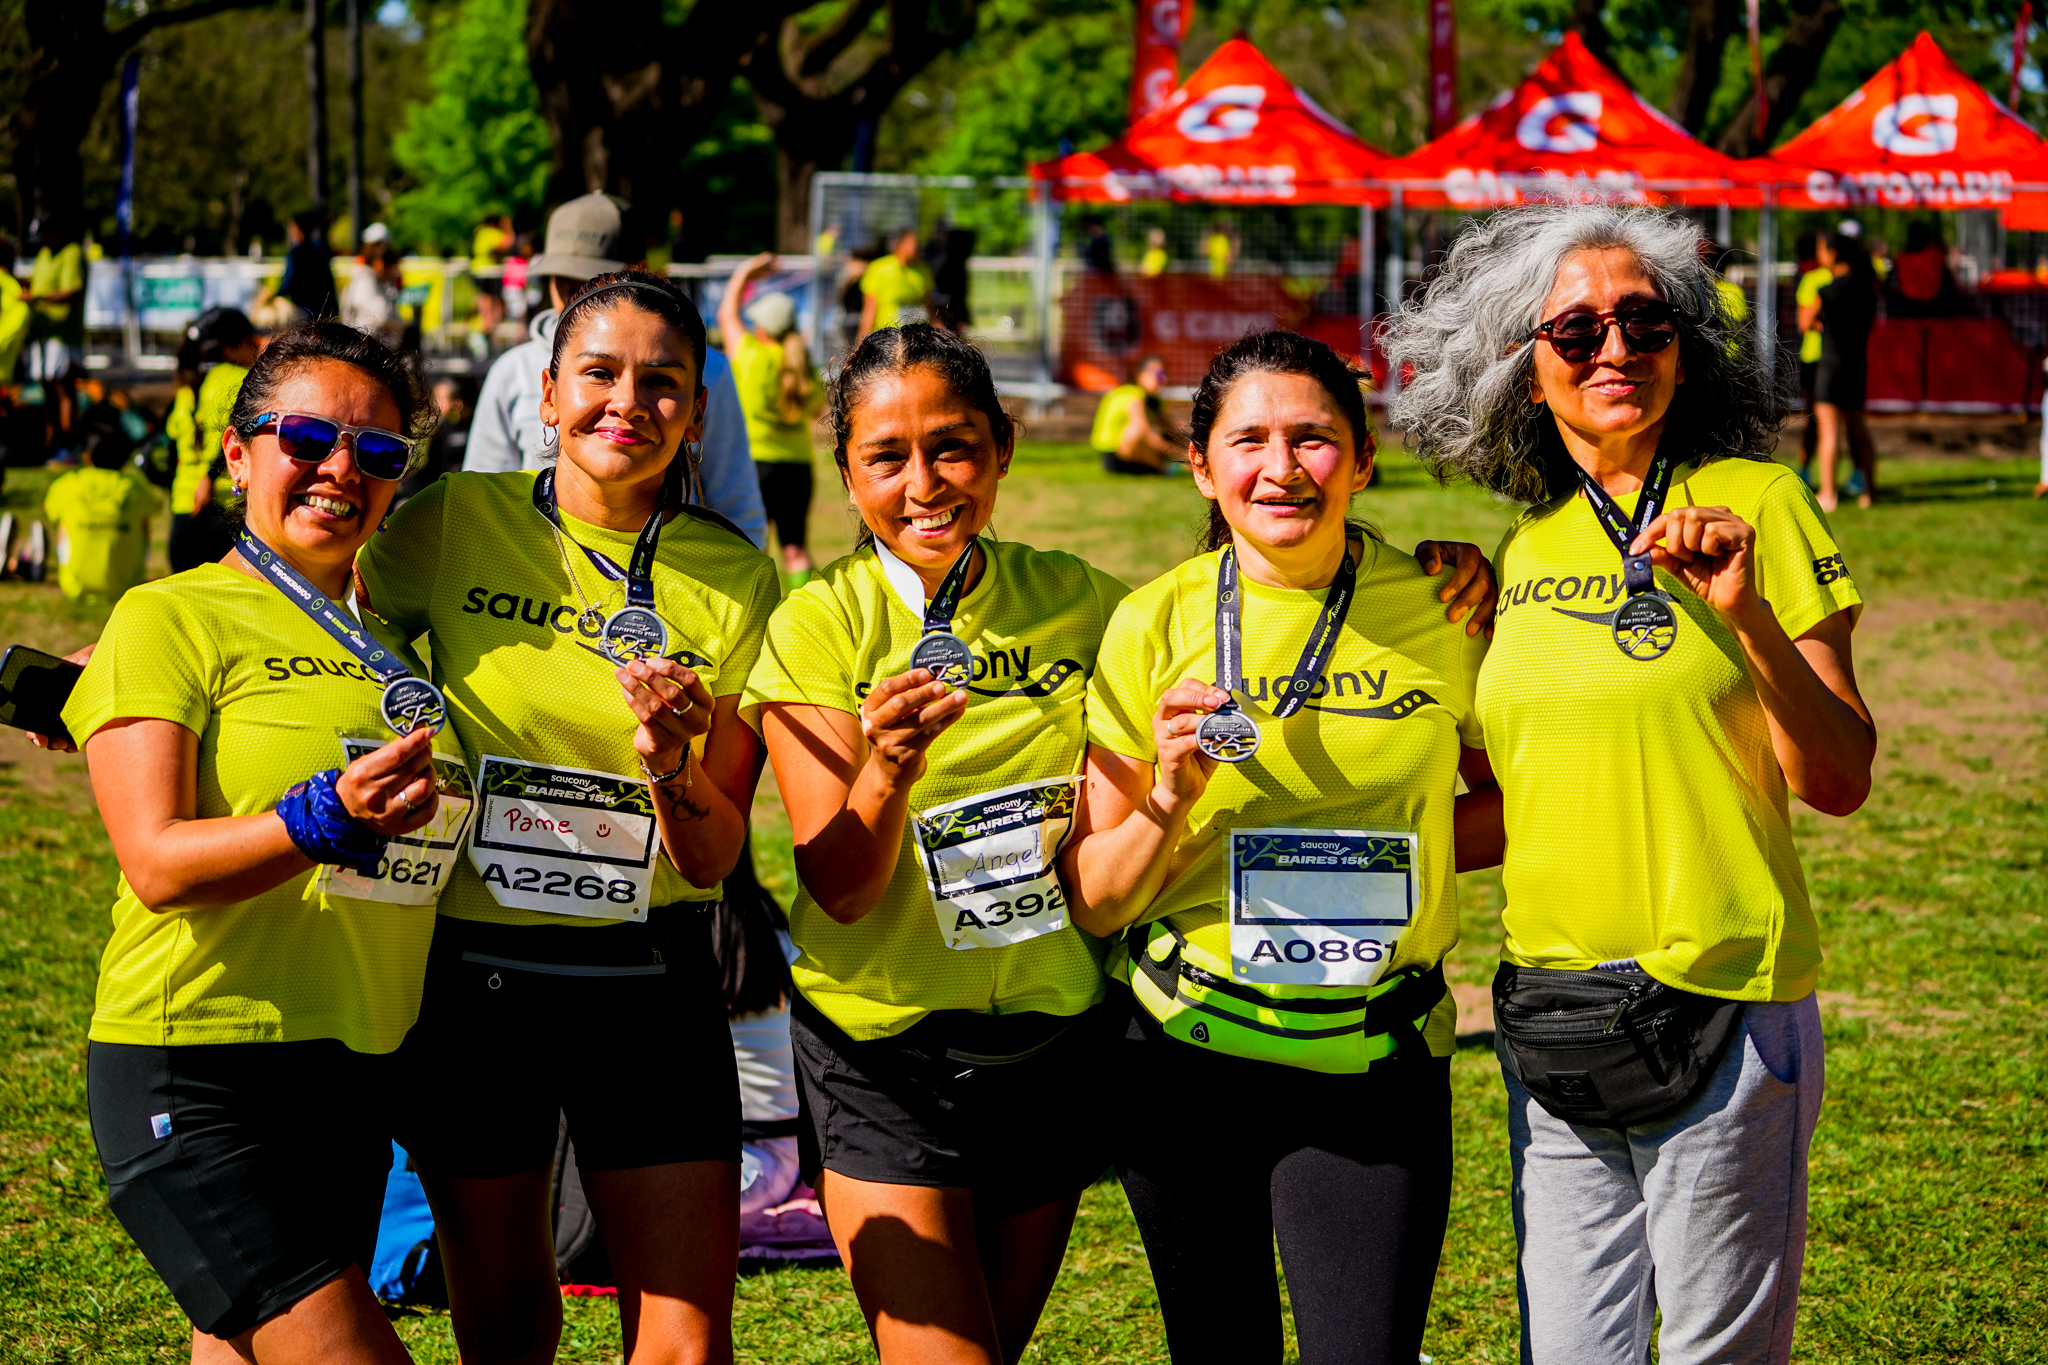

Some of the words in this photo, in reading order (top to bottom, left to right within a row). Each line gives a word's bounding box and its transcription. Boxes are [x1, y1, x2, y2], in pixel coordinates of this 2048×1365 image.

[1175, 84, 1266, 143] G
[1516, 92, 1603, 154] G
[1872, 93, 1958, 156] G
[1331, 589, 1347, 618] saucony
[1495, 573, 1627, 624] aucony
[1313, 624, 1332, 657] BAIRES
[1307, 656, 1318, 672] 15K
[550, 774, 591, 788] saucony
[525, 784, 587, 801] BAIRES
[588, 793, 618, 805] 15K
[982, 798, 1022, 815] saucony
[486, 798, 495, 829] NOMBRE
[504, 808, 574, 834] Pame
[964, 812, 1024, 836] BAIRES
[485, 829, 490, 838] TU
[1300, 841, 1341, 850] saucony
[1278, 855, 1339, 865] BAIRES
[1340, 857, 1369, 865] 15K
[482, 863, 637, 904] A2268
[1245, 904, 1250, 914] TU
[1250, 939, 1398, 963] A0861
